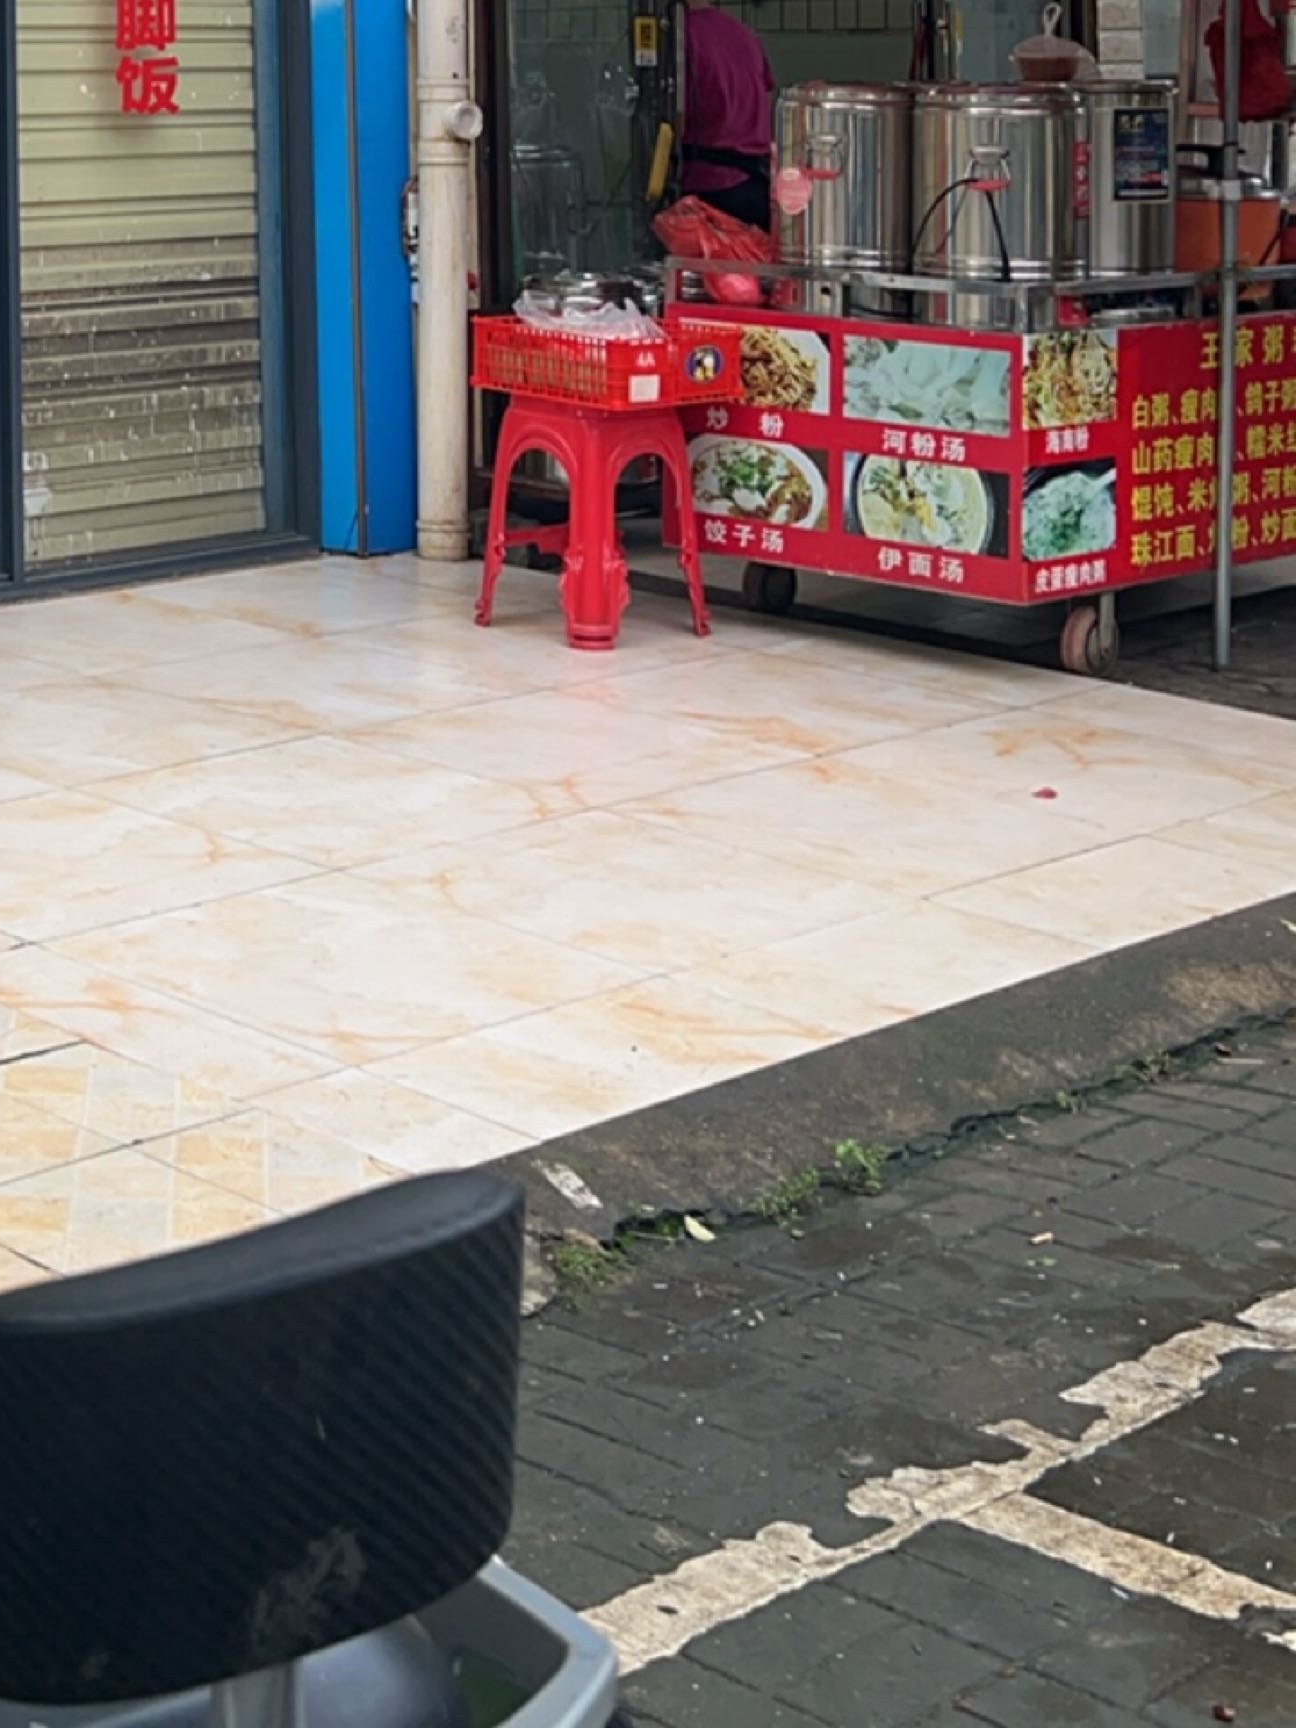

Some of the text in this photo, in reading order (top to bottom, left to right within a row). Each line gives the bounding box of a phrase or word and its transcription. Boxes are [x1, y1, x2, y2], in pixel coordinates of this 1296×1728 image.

[1200, 324, 1296, 370] 王家粥
[882, 428, 967, 462] 河粉汤
[704, 518, 785, 554] 饺子汤
[878, 546, 965, 584] 伊面汤
